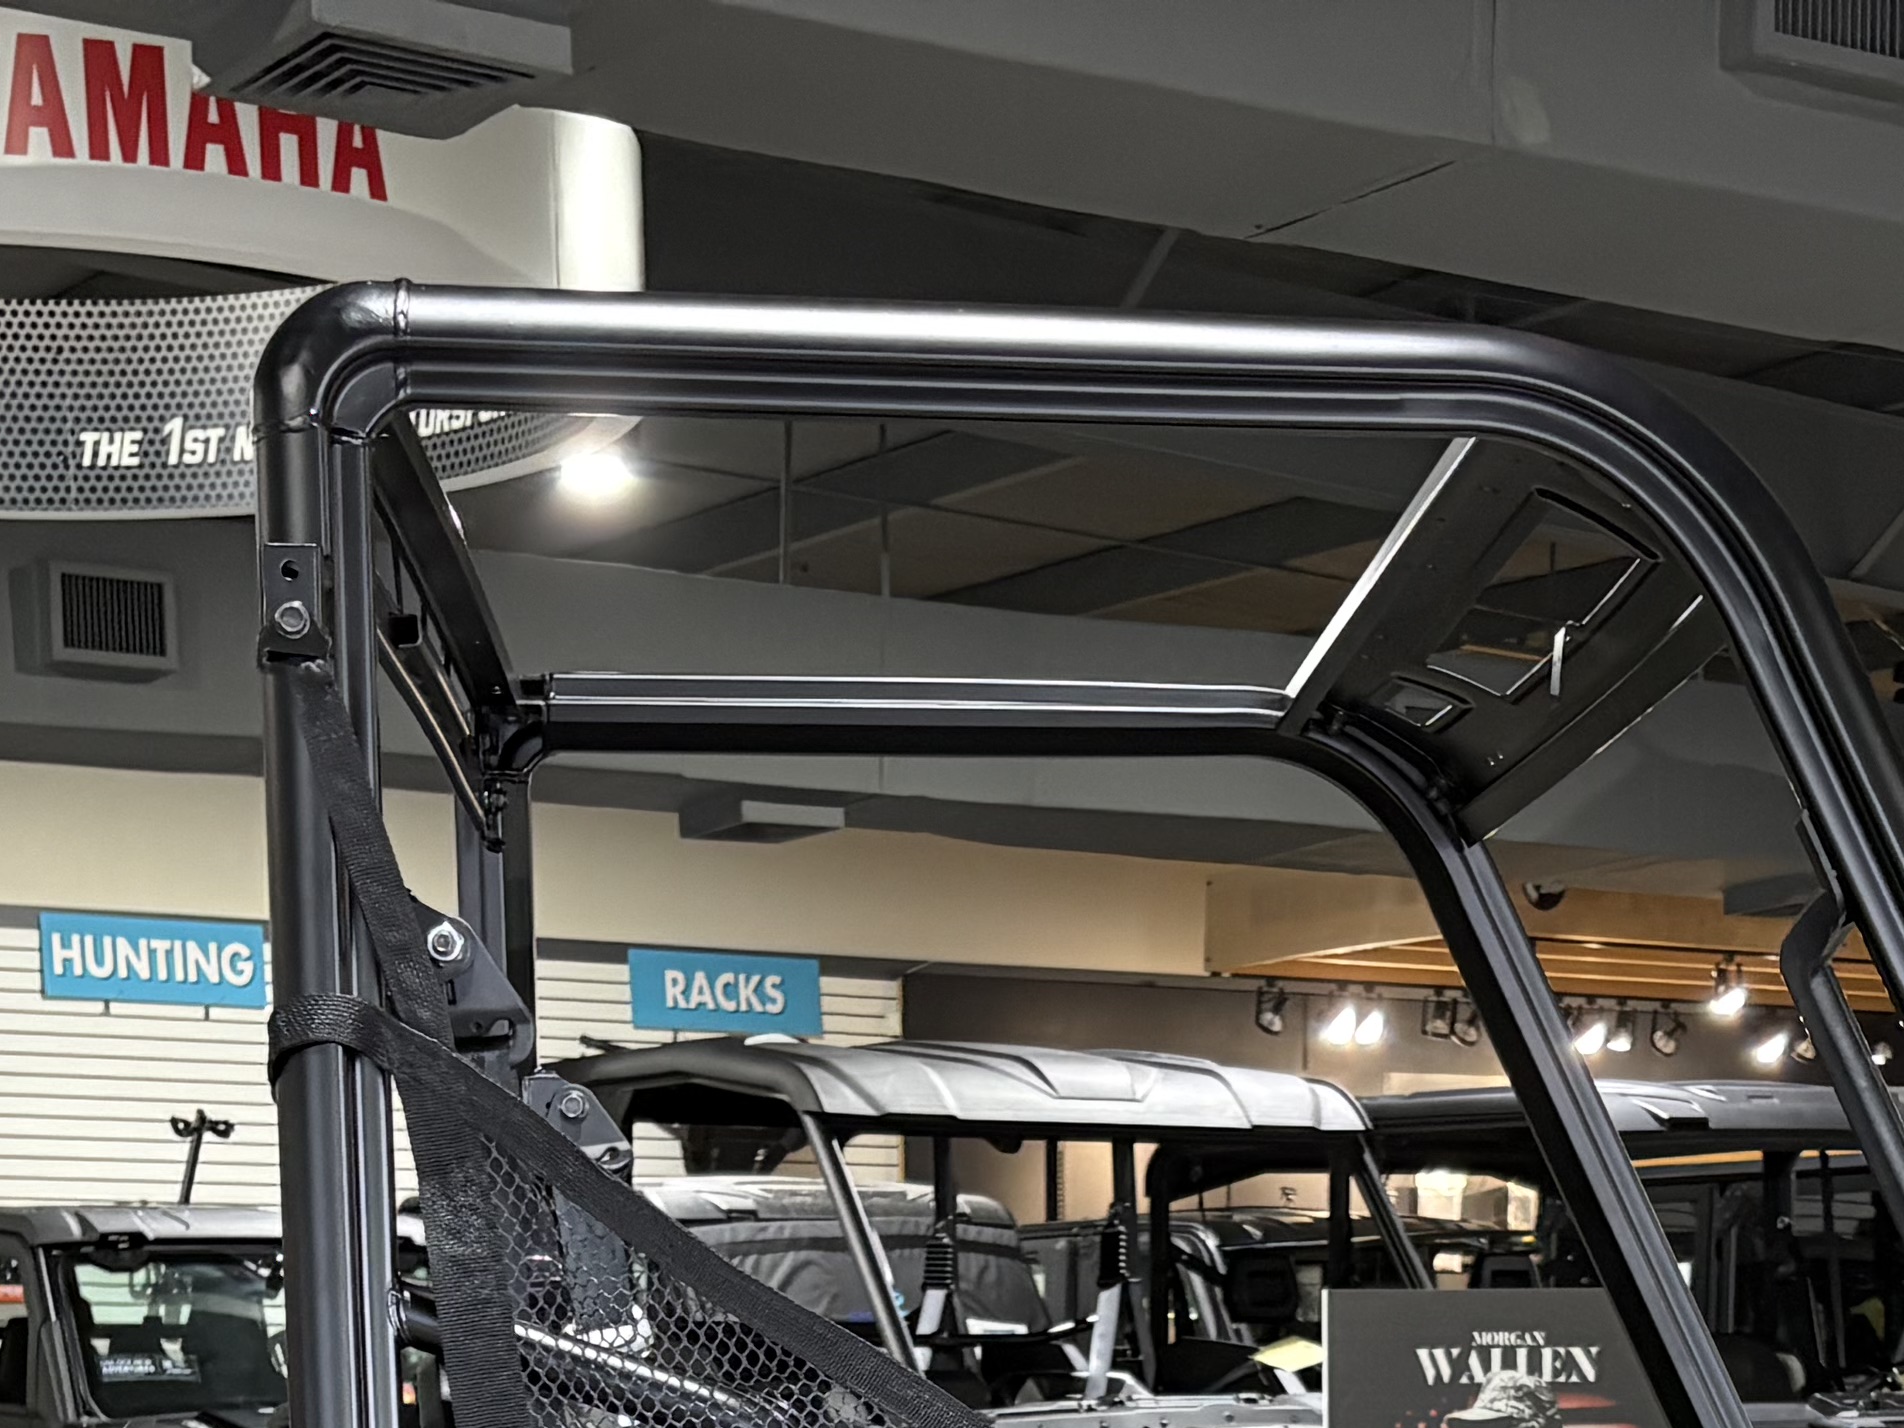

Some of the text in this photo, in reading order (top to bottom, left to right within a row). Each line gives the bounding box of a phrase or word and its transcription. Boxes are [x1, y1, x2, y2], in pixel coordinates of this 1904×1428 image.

[79, 430, 143, 467] THE
[163, 416, 226, 465] 1ST
[51, 931, 254, 988] HUNTING
[664, 969, 785, 1015] RACKS
[1471, 1330, 1547, 1347] MORGAN
[1415, 1346, 1600, 1386] WALLEN
